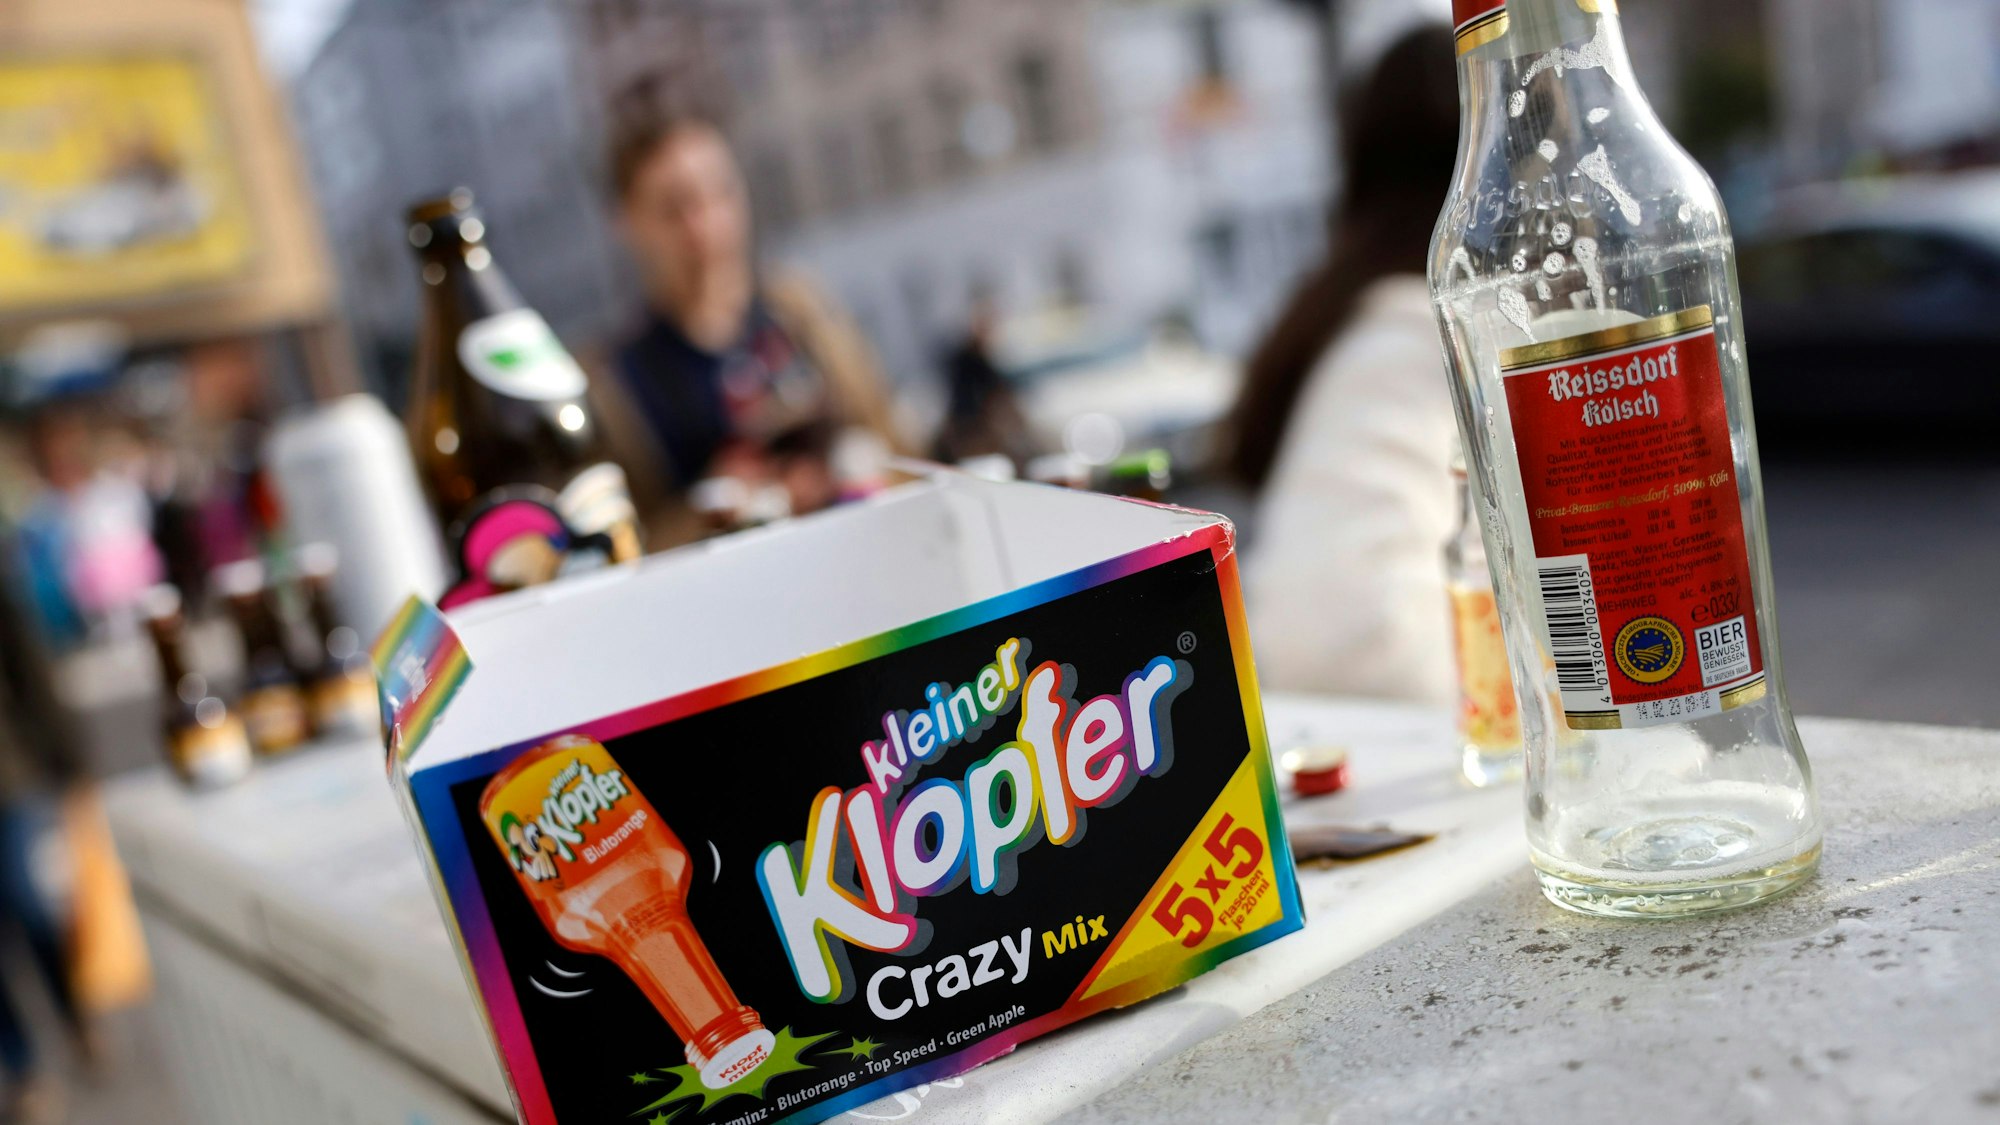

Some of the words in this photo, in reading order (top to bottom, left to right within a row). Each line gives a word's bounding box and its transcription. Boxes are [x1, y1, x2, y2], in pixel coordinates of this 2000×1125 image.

[1548, 346, 1679, 402] Reissdorf
[1581, 388, 1660, 428] Kölsch
[1560, 439, 1576, 450] Mit
[1579, 421, 1669, 447] Rücksichtnahme
[1671, 416, 1687, 428] auf
[1594, 439, 1639, 456] Reinheit
[1641, 435, 1663, 447] und
[1665, 424, 1702, 442] Umwelt
[1545, 458, 1604, 476] verwenden
[1606, 455, 1623, 466] wir
[1626, 451, 1645, 462] nur
[1648, 436, 1707, 457] erstklassige
[1545, 473, 1595, 489] Rohstoffe
[1598, 470, 1617, 480] aus
[1620, 456, 1680, 476] deutschem
[1682, 447, 1712, 460] Anbau
[1566, 486, 1581, 497] für
[1584, 481, 1616, 494] unser
[1618, 468, 1676, 487] feinherbes
[1673, 479, 1706, 497] 50996
[1707, 469, 1729, 488] Köln
[1590, 560, 1620, 573] malz,
[1593, 575, 1611, 586] Gut
[1613, 568, 1652, 585] gekühlt
[1654, 564, 1674, 577] und
[1676, 551, 1723, 572] hygienisch
[1578, 570, 1598, 625] 003405
[1595, 580, 1657, 597] einwandfrei
[1597, 593, 1658, 613] MEHRWEG
[1626, 619, 1678, 642] GEOGRAPHISCHE
[1700, 621, 1744, 650] BIER
[1589, 632, 1609, 686] 013060
[1702, 641, 1745, 662] BEWUSST
[1703, 651, 1746, 671] GENIESSEN.
[861, 637, 1020, 795] kleiner
[538, 764, 631, 862] Klopfer
[755, 655, 1177, 1003] Klopfer
[581, 808, 648, 865] Blutorange
[1151, 812, 1263, 948] 5x5
[1217, 869, 1263, 926] Flaschen
[1232, 913, 1245, 931] je
[1241, 896, 1258, 916] 20
[1254, 878, 1270, 898] ml
[866, 928, 1032, 1021] Crazy
[1042, 914, 1109, 961] Mix
[718, 1044, 763, 1079] Klopf
[728, 1051, 769, 1083] mich!
[777, 1070, 857, 1111] Blutorange
[865, 1060, 892, 1075] Top
[893, 1038, 937, 1065] Speed
[946, 1022, 986, 1046] Green
[988, 1004, 1026, 1029] Apple
